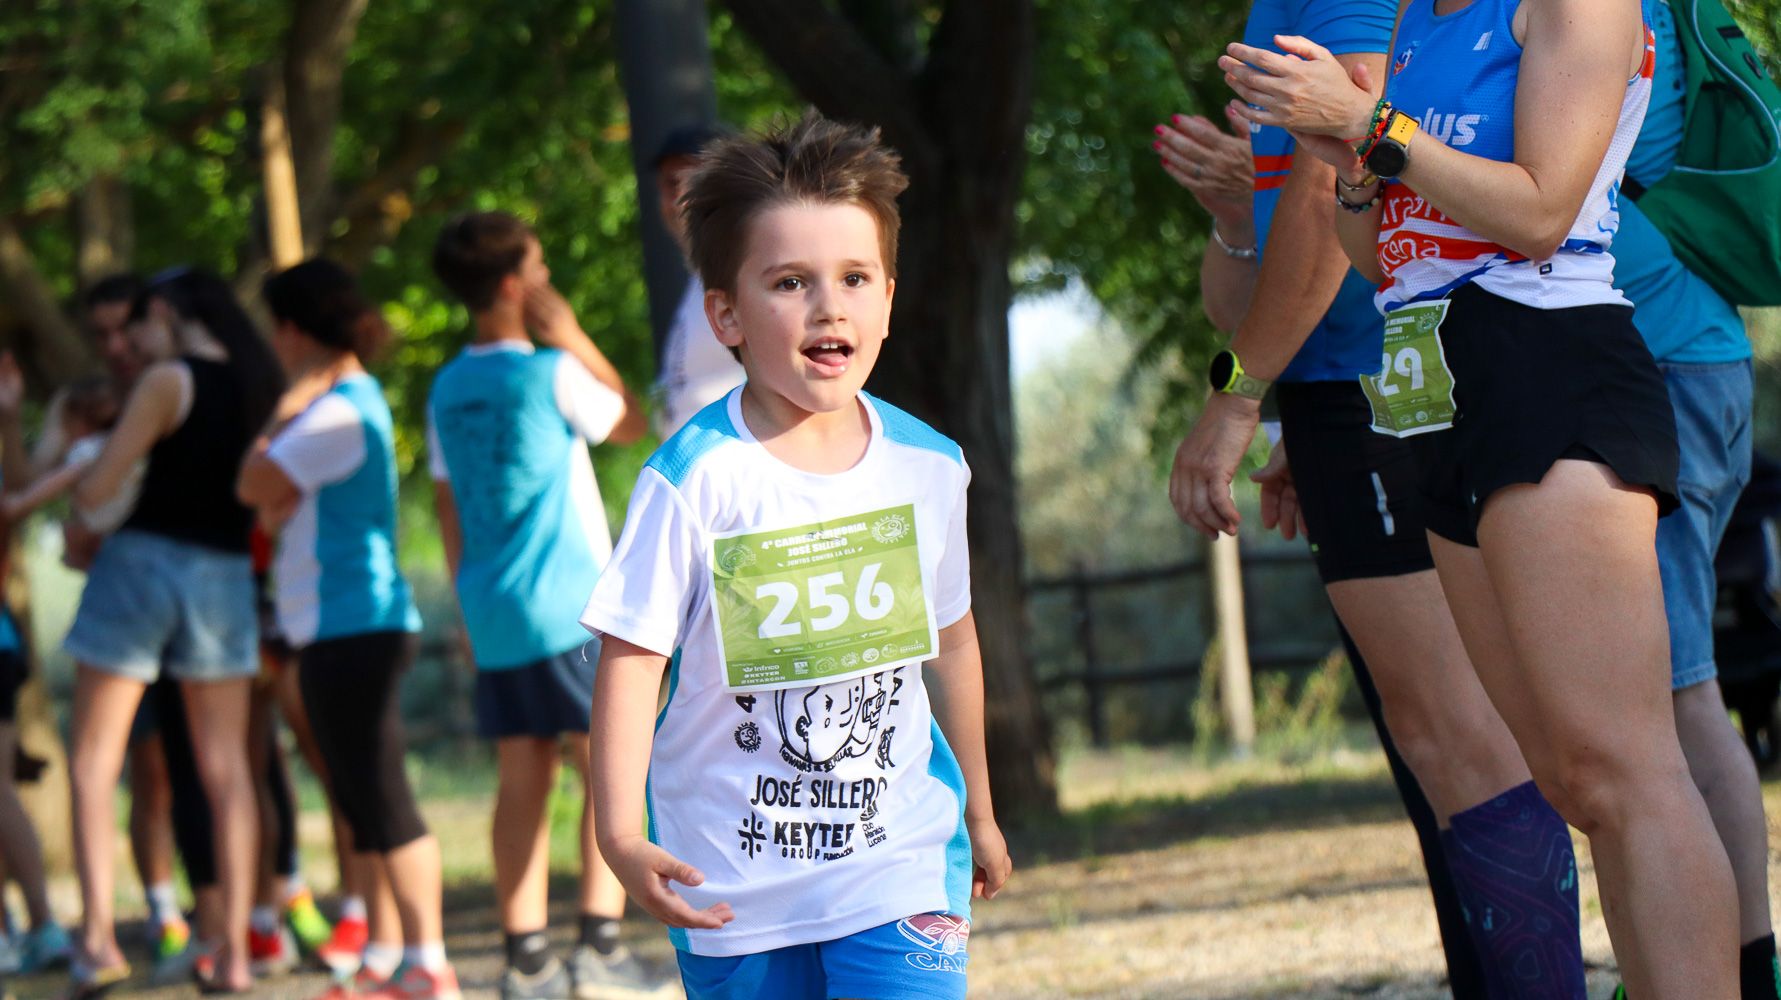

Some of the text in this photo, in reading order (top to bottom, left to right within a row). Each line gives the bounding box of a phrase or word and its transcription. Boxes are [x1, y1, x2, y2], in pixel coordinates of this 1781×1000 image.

[1414, 107, 1480, 146] lus
[774, 531, 819, 548] CARRE
[811, 552, 834, 562] CONTRA
[755, 562, 895, 640] 256
[750, 773, 802, 806] JOSÉ
[782, 847, 820, 860] GROUP
